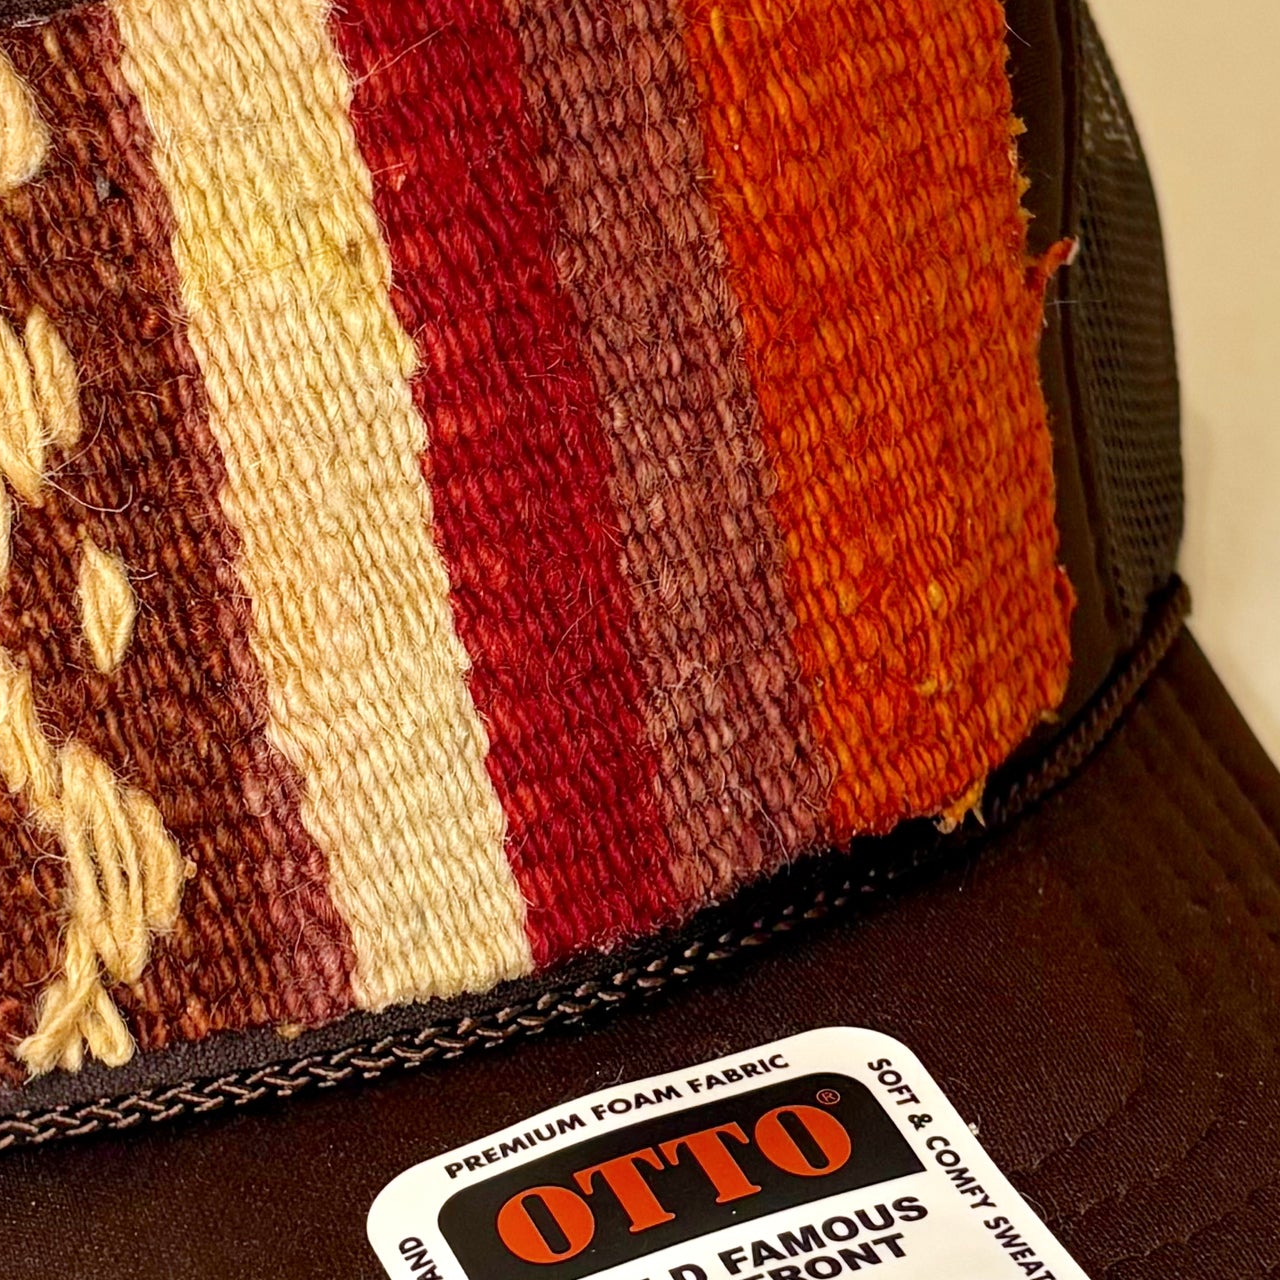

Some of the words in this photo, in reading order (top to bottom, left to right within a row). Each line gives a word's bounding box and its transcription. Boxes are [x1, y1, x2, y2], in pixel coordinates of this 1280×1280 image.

[445, 1112, 586, 1180] PREMIUM
[591, 1082, 684, 1123] FOAM
[688, 1053, 791, 1095] FABRIC
[496, 1104, 852, 1265] OTTO
[867, 1056, 919, 1112] SOFT
[908, 1112, 932, 1130] &
[925, 1135, 995, 1209] COMFY
[719, 1196, 930, 1278] FAMOUS
